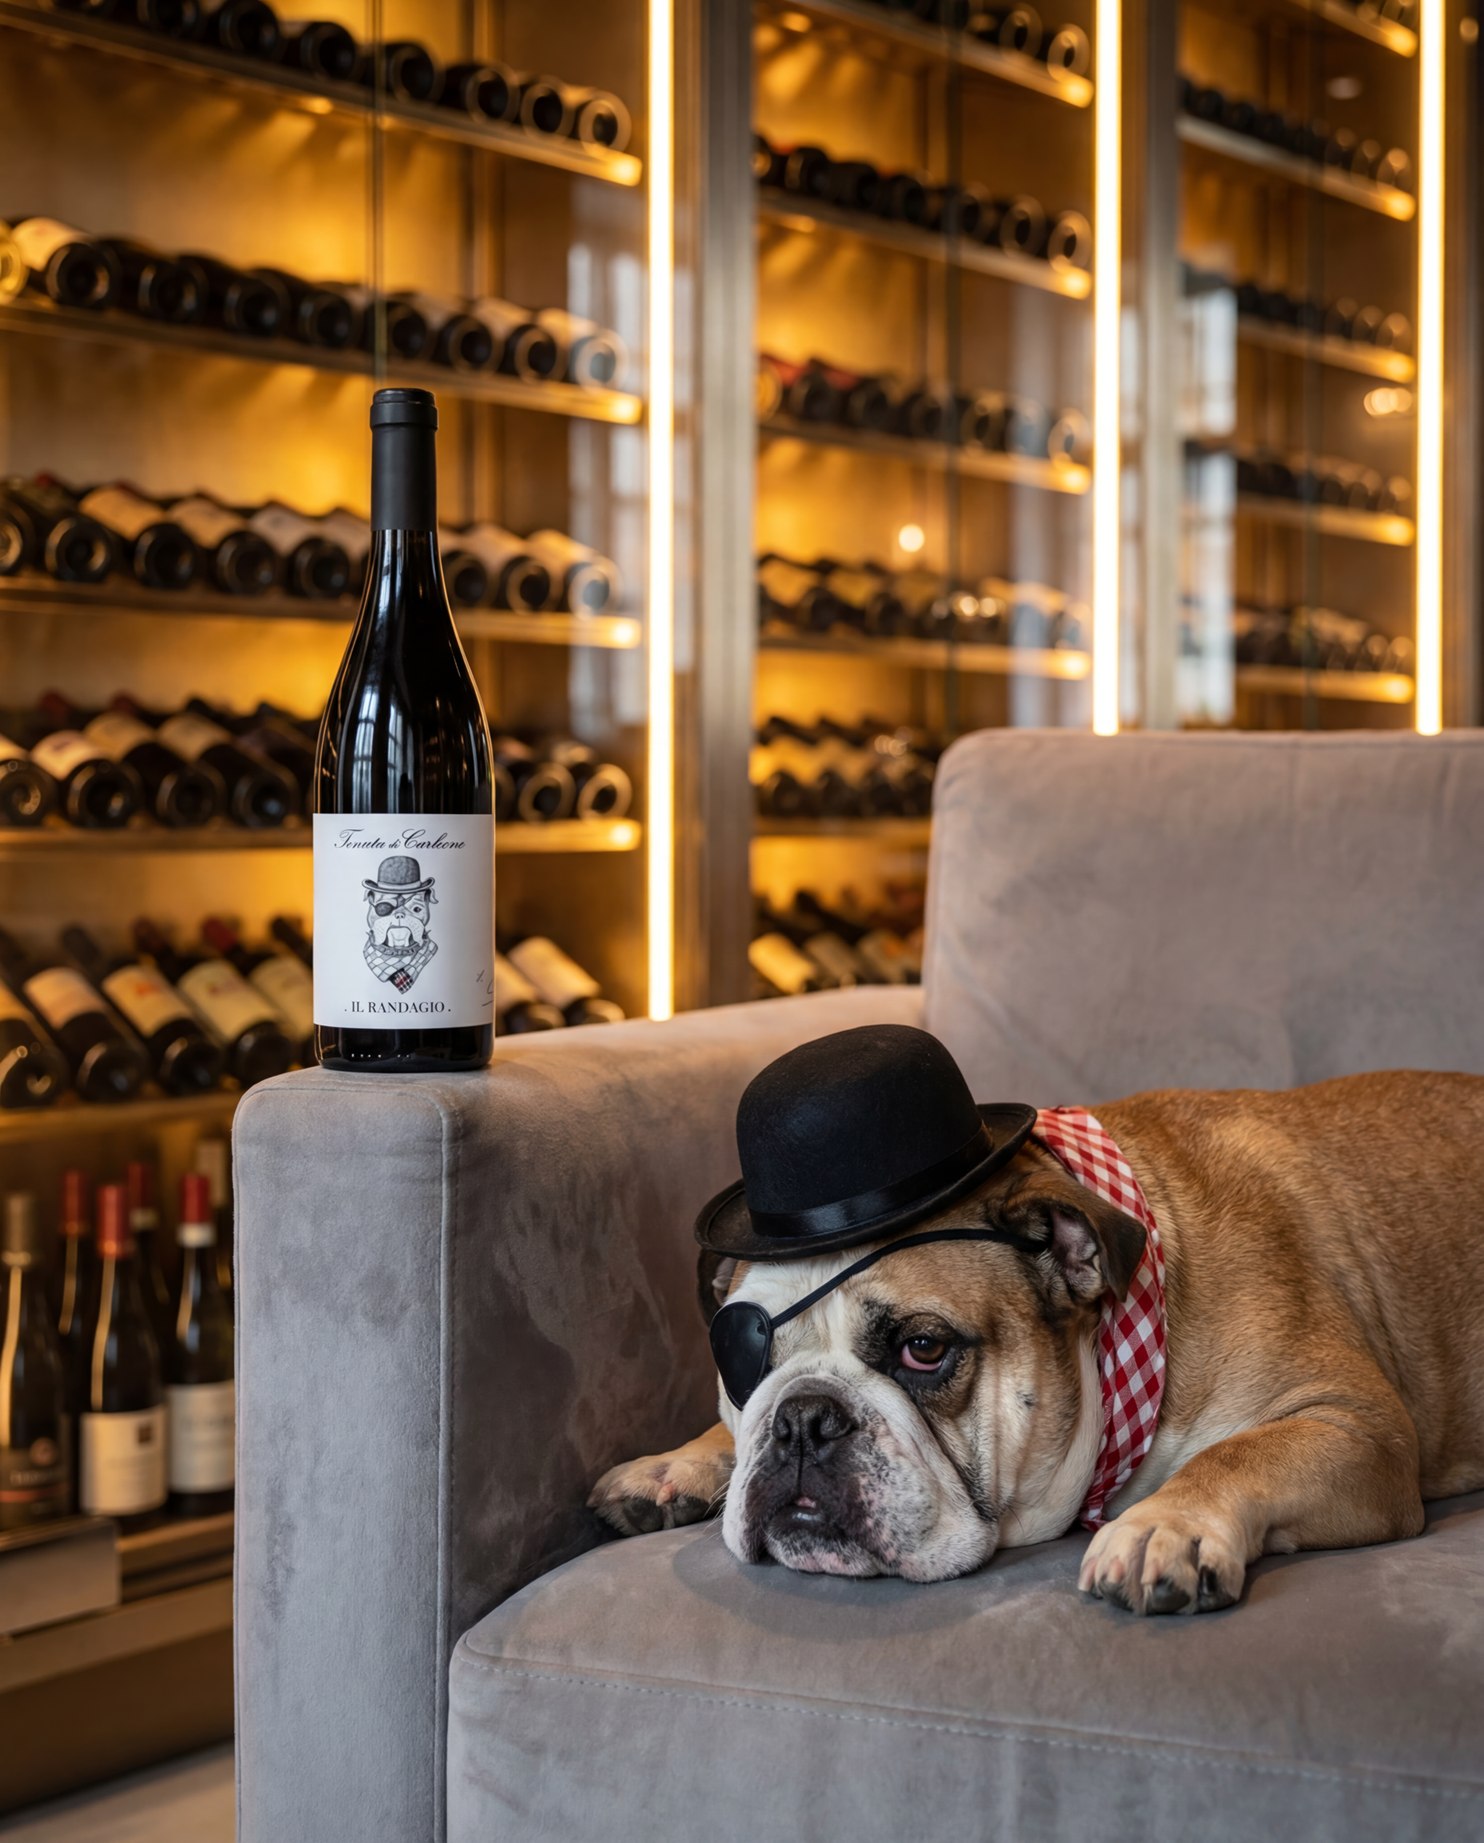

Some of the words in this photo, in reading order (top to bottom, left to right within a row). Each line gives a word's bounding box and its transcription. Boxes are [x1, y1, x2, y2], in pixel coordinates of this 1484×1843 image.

[334, 828, 386, 849] Tenuta
[388, 838, 401, 849] di
[401, 828, 466, 850] Carleone
[368, 1001, 445, 1013] RANDAGIO
